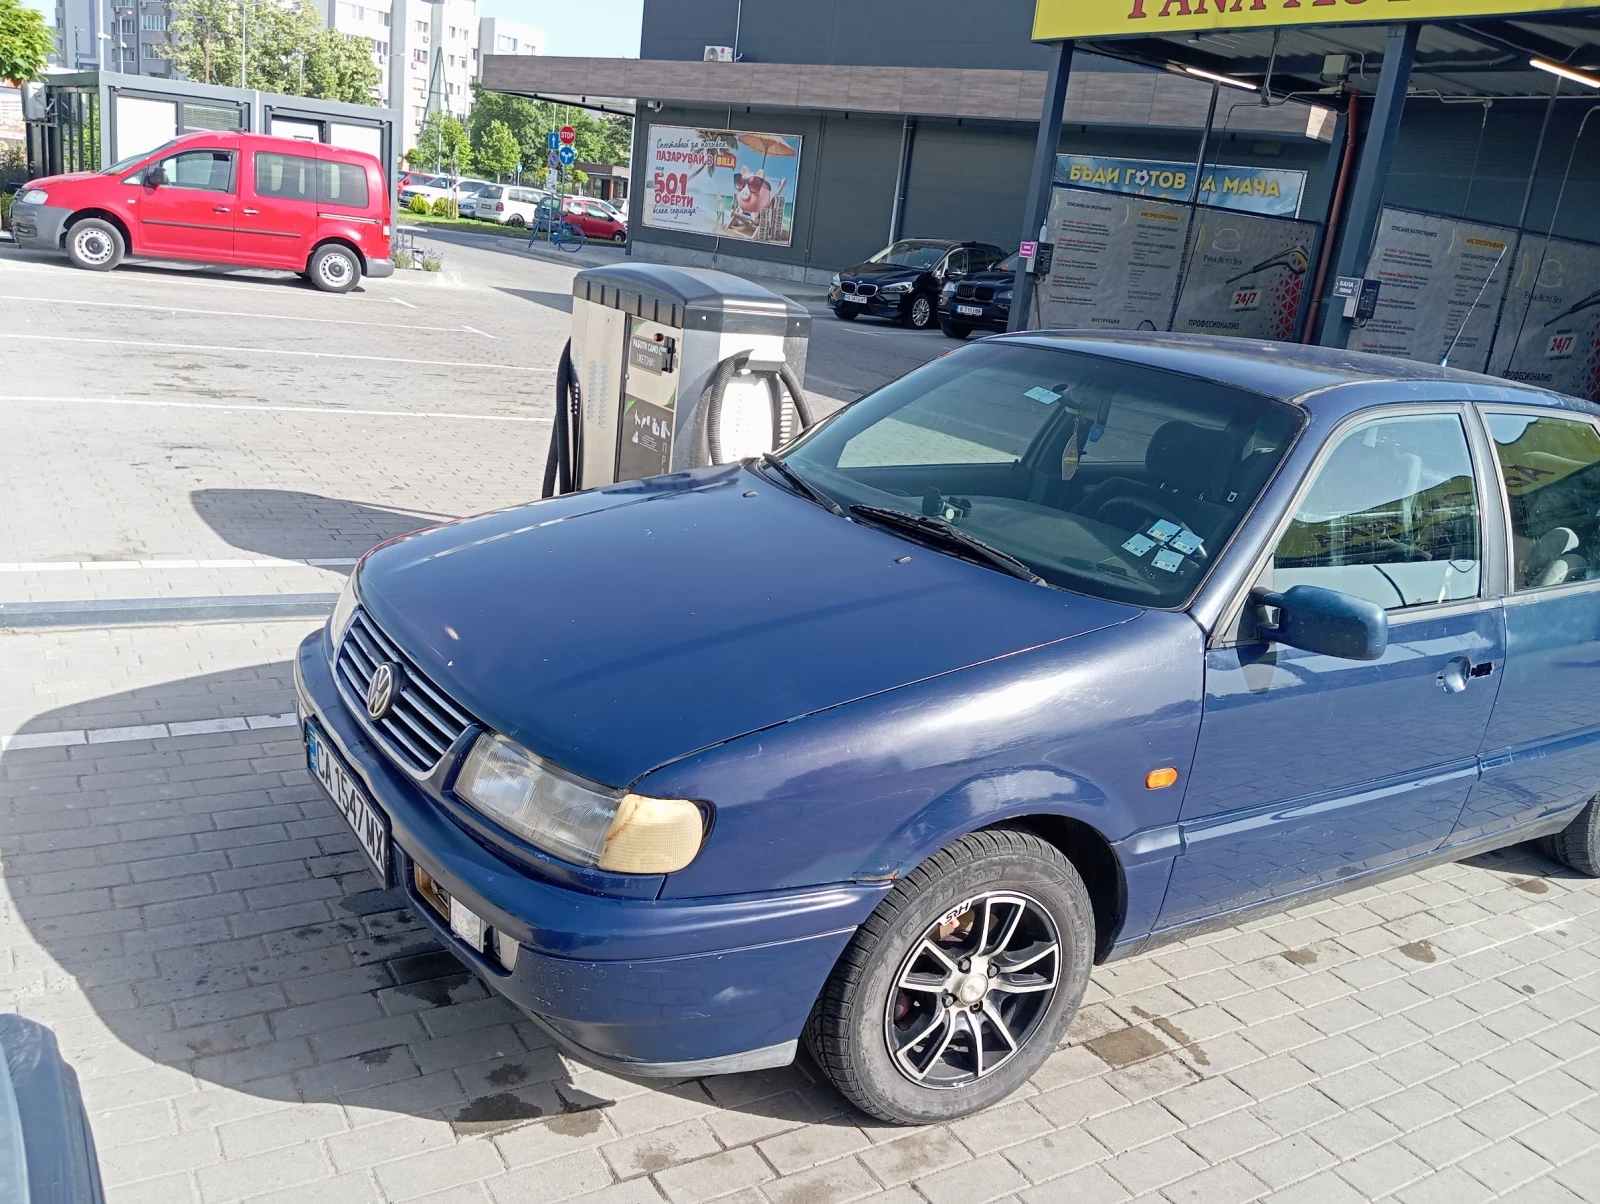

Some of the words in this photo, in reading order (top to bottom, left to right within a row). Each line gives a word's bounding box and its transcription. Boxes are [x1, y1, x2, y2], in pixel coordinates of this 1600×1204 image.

[561, 131, 574, 139] STOP
[656, 151, 705, 165] ПАЗАРУВАЙ
[707, 155, 713, 165] В
[716, 156, 735, 167] BILLA
[654, 172, 688, 196] 501
[1069, 164, 1120, 185] БЪДИ
[1222, 176, 1280, 197] МАЧА
[654, 193, 694, 208] ОФЕРТИ
[1234, 292, 1258, 306] 24/7
[1188, 319, 1240, 330] ПРОФЕСИОНАЛНО
[1550, 336, 1574, 354] 24/7
[317, 741, 334, 792] CA
[335, 767, 364, 832] 1547
[366, 808, 384, 870] MX
